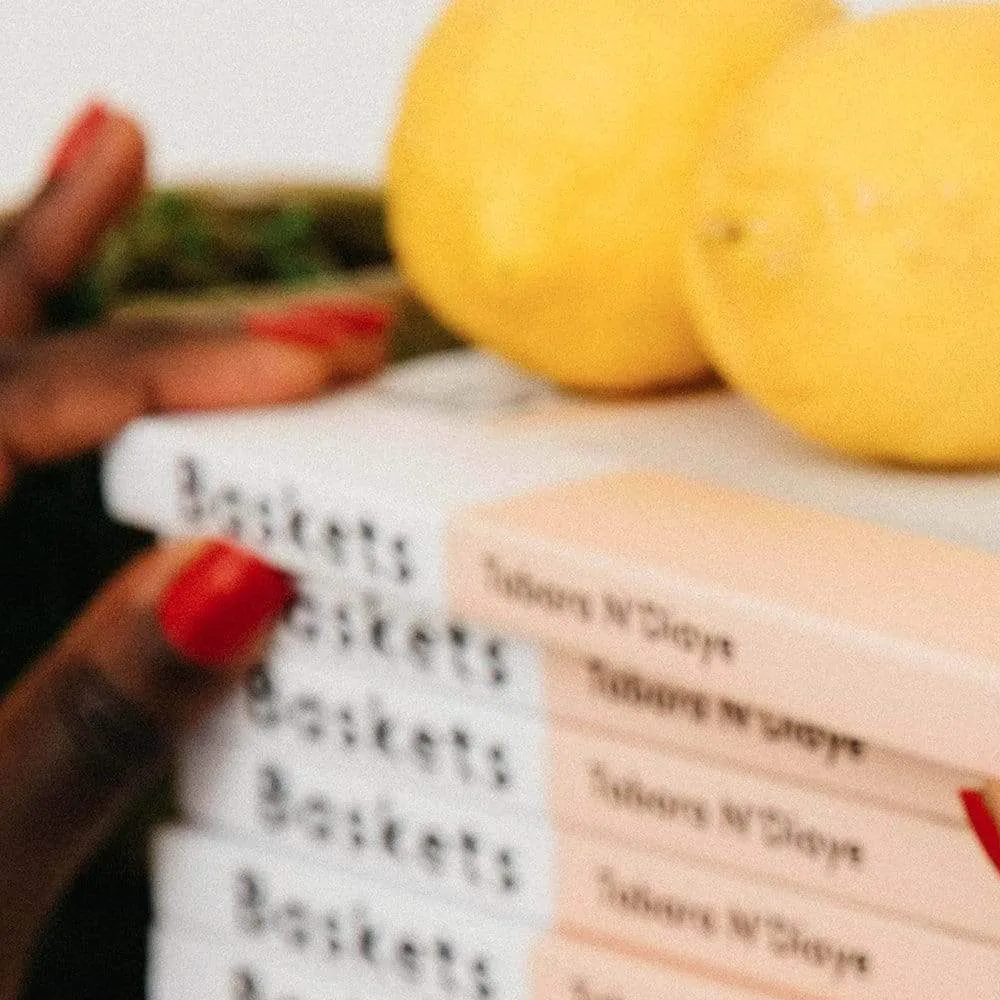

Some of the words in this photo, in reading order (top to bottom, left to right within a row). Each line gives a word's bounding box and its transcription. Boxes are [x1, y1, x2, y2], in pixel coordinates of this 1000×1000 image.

[178, 458, 413, 582] Baskets
[284, 582, 508, 686] askets
[260, 766, 518, 888] Baskets
[237, 872, 490, 998] Baskets
